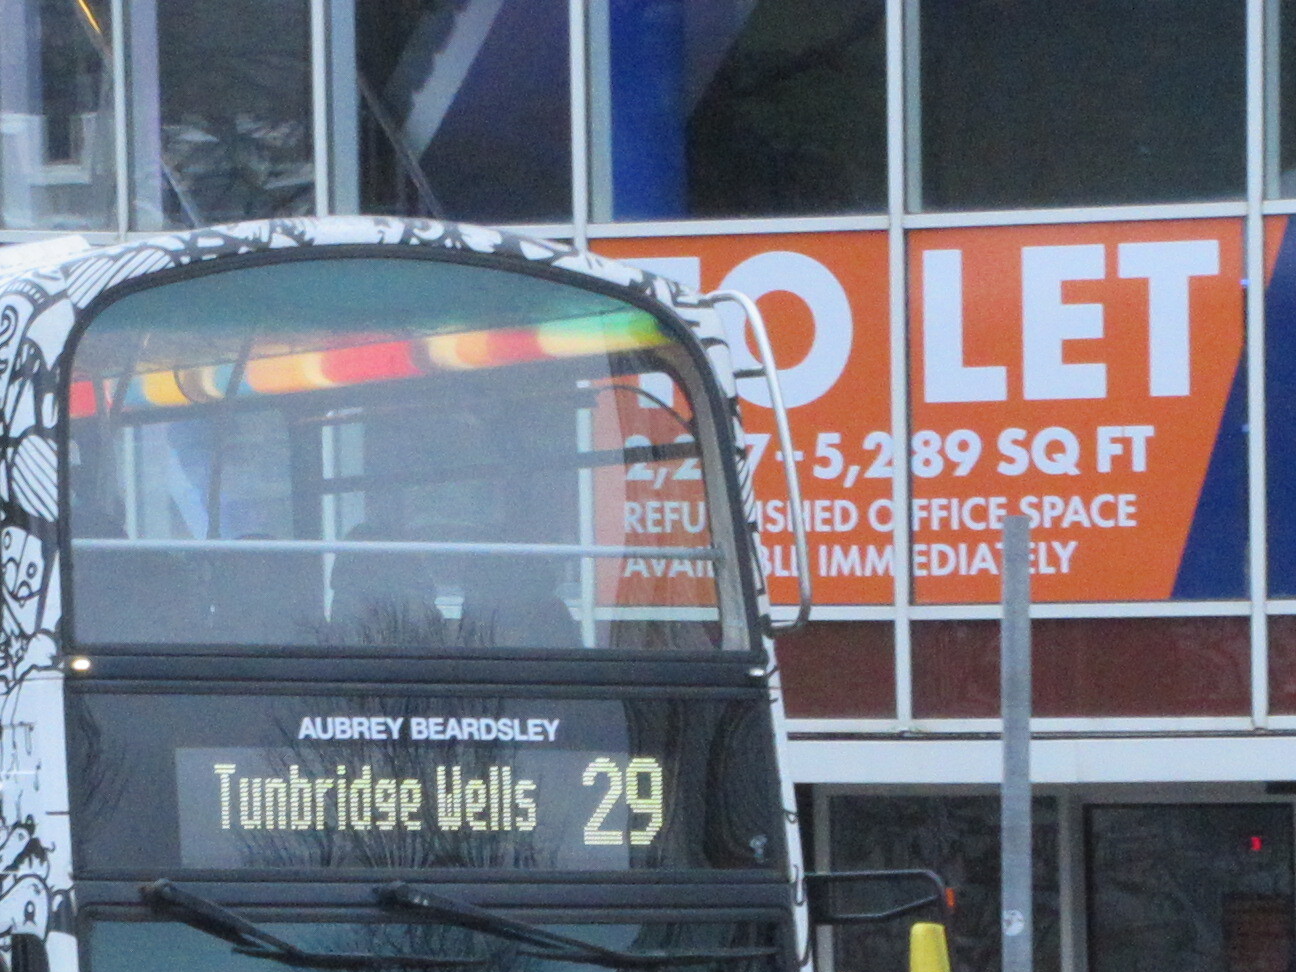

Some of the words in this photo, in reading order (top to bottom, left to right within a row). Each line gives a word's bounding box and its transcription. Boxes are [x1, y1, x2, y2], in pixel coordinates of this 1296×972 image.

[922, 239, 1220, 403] LET
[997, 426, 1081, 476] SQ
[1097, 425, 1155, 473] FT
[624, 499, 858, 533] REFUISHED
[867, 496, 1008, 532] OFFICE
[1019, 494, 1137, 529] SPACE
[299, 715, 403, 741] AUBREY
[410, 716, 559, 743] BEARDSLEY
[214, 763, 422, 832] Tunbridge
[436, 764, 538, 832] Wells
[581, 756, 664, 846] 29
